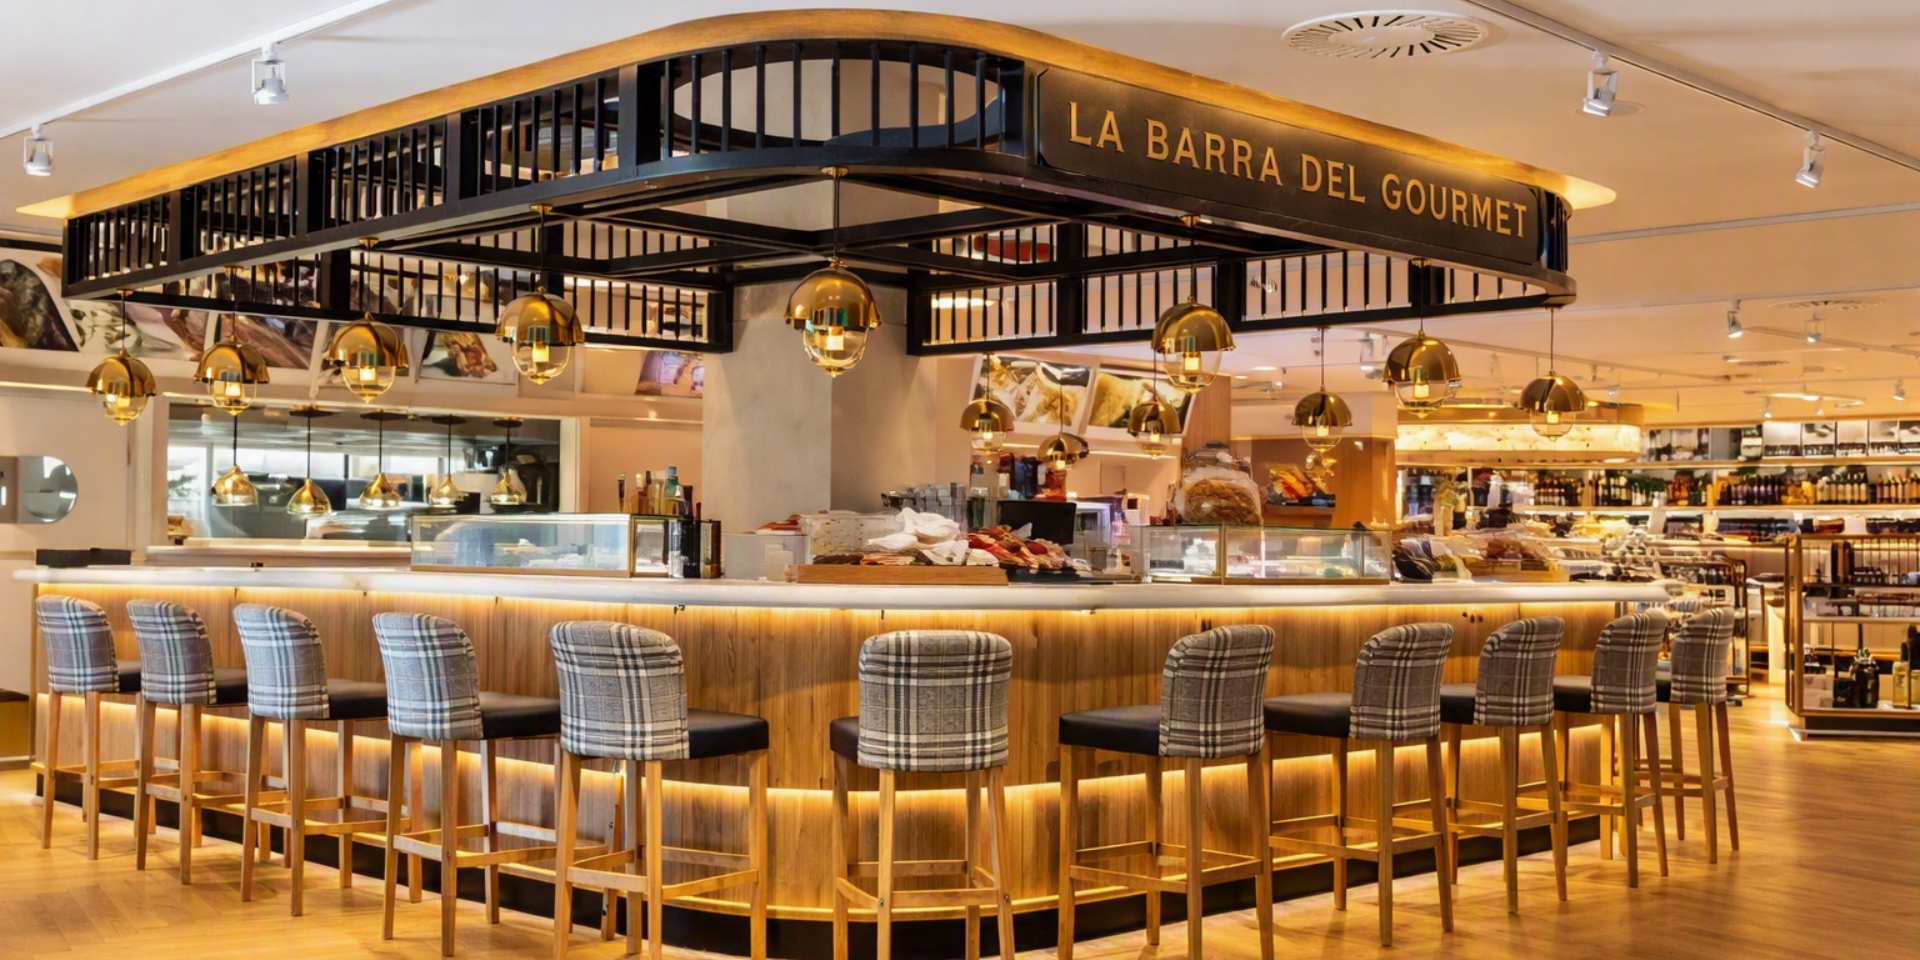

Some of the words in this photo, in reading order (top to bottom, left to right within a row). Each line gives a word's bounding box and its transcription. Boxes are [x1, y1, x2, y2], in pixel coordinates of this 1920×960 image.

[1069, 102, 1125, 153] LA
[1146, 119, 1283, 185] BARRA
[1300, 153, 1366, 204] DEL
[1382, 173, 1527, 238] GOURMET
